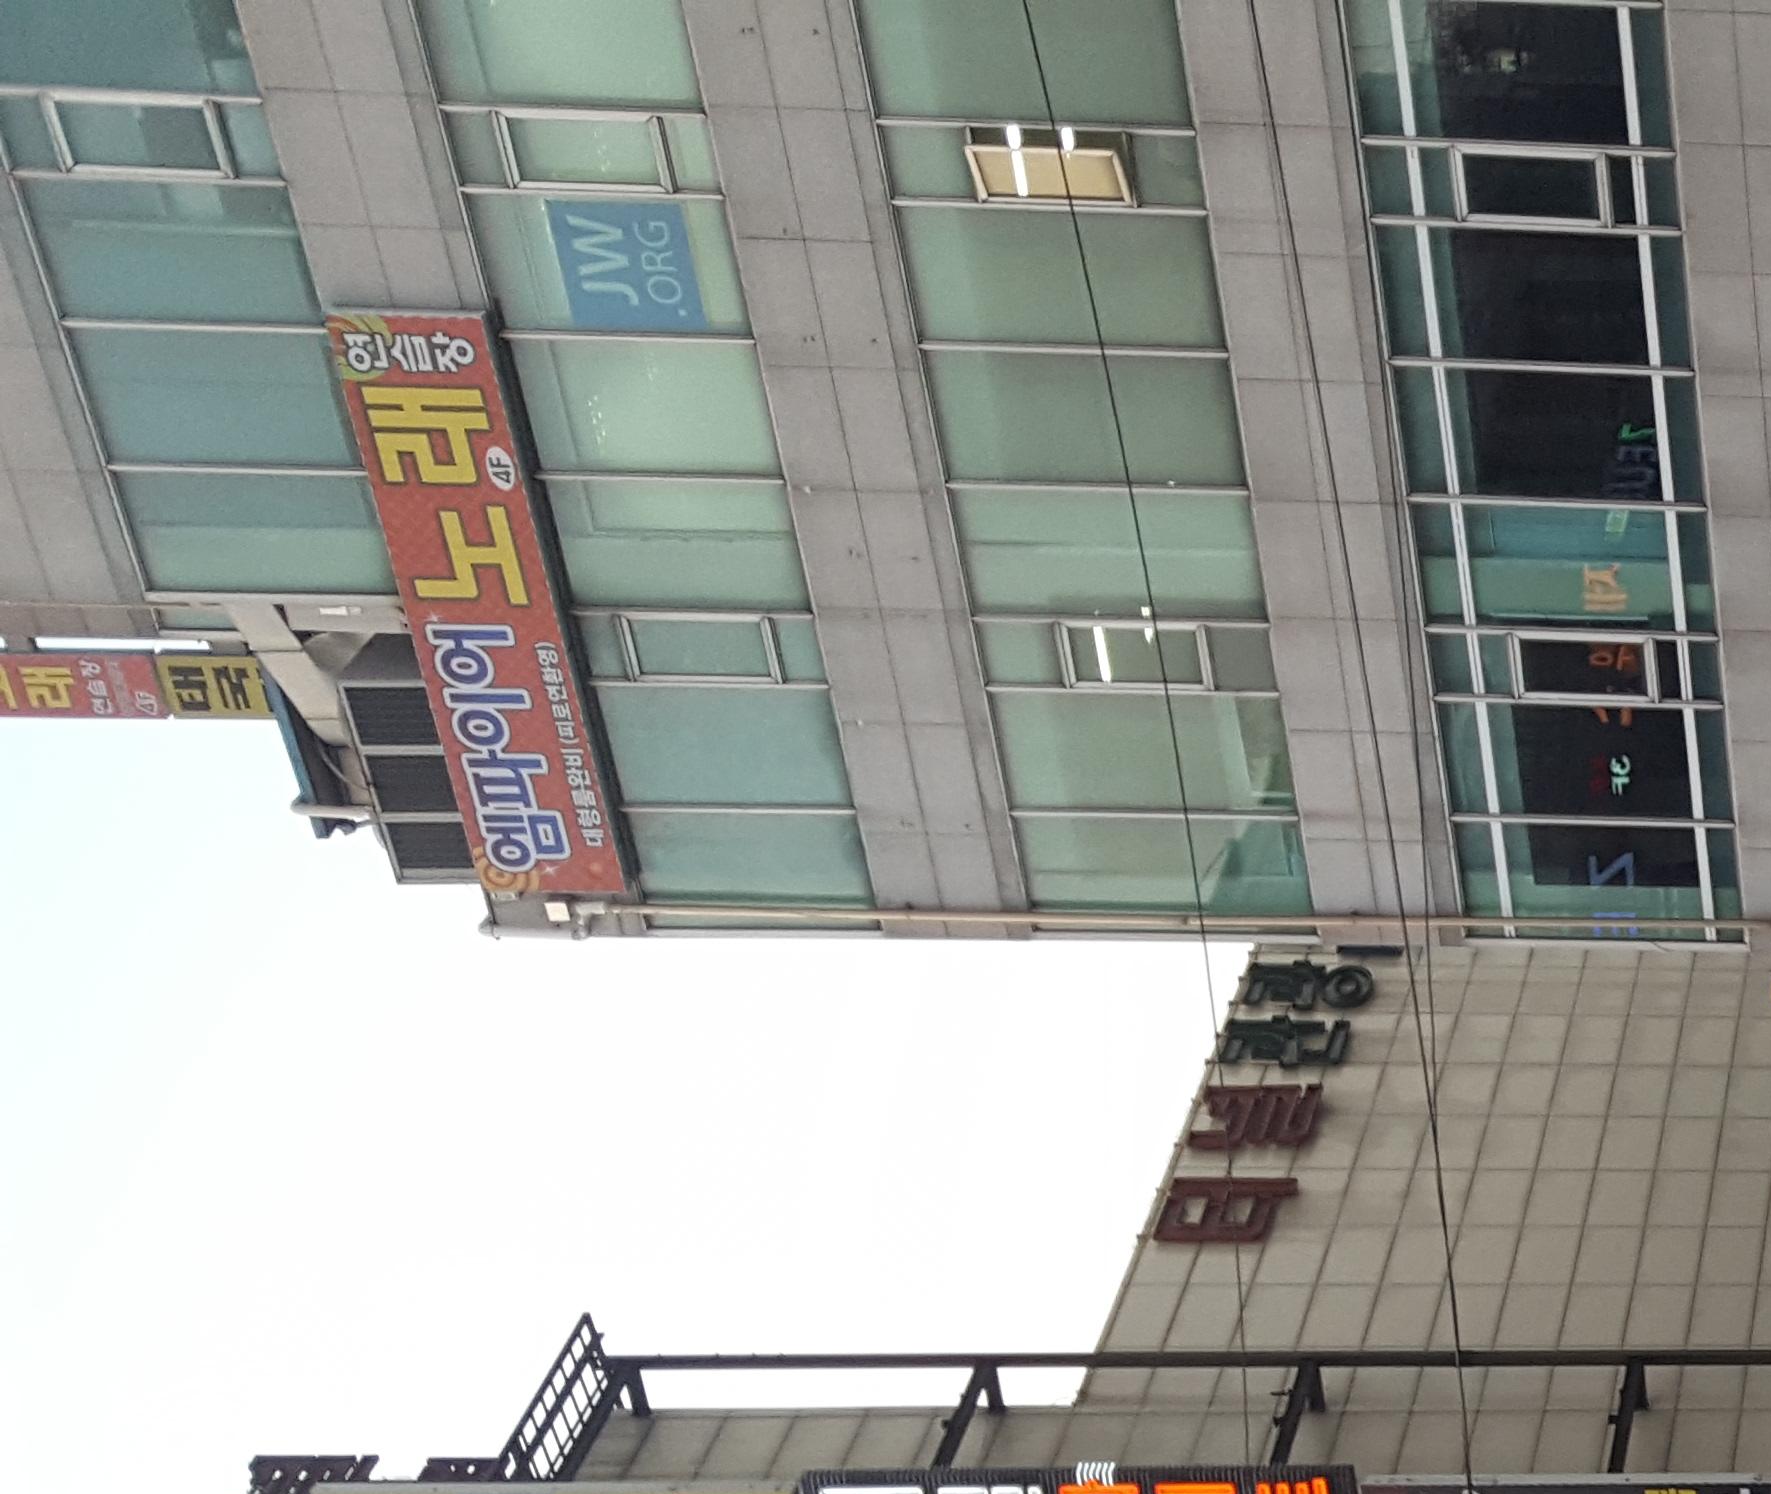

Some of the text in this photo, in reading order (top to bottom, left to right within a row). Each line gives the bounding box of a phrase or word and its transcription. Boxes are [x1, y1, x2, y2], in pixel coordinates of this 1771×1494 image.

[565, 214, 640, 306] JW
[632, 220, 688, 317] .ORG
[488, 456, 512, 484] 4F
[344, 331, 572, 872] 엠파이어 노래 연습장
[166, 664, 252, 712] 태국
[533, 640, 606, 848] 대형룸완비 (피로연환영)
[1150, 1083, 1326, 1244] 터널
